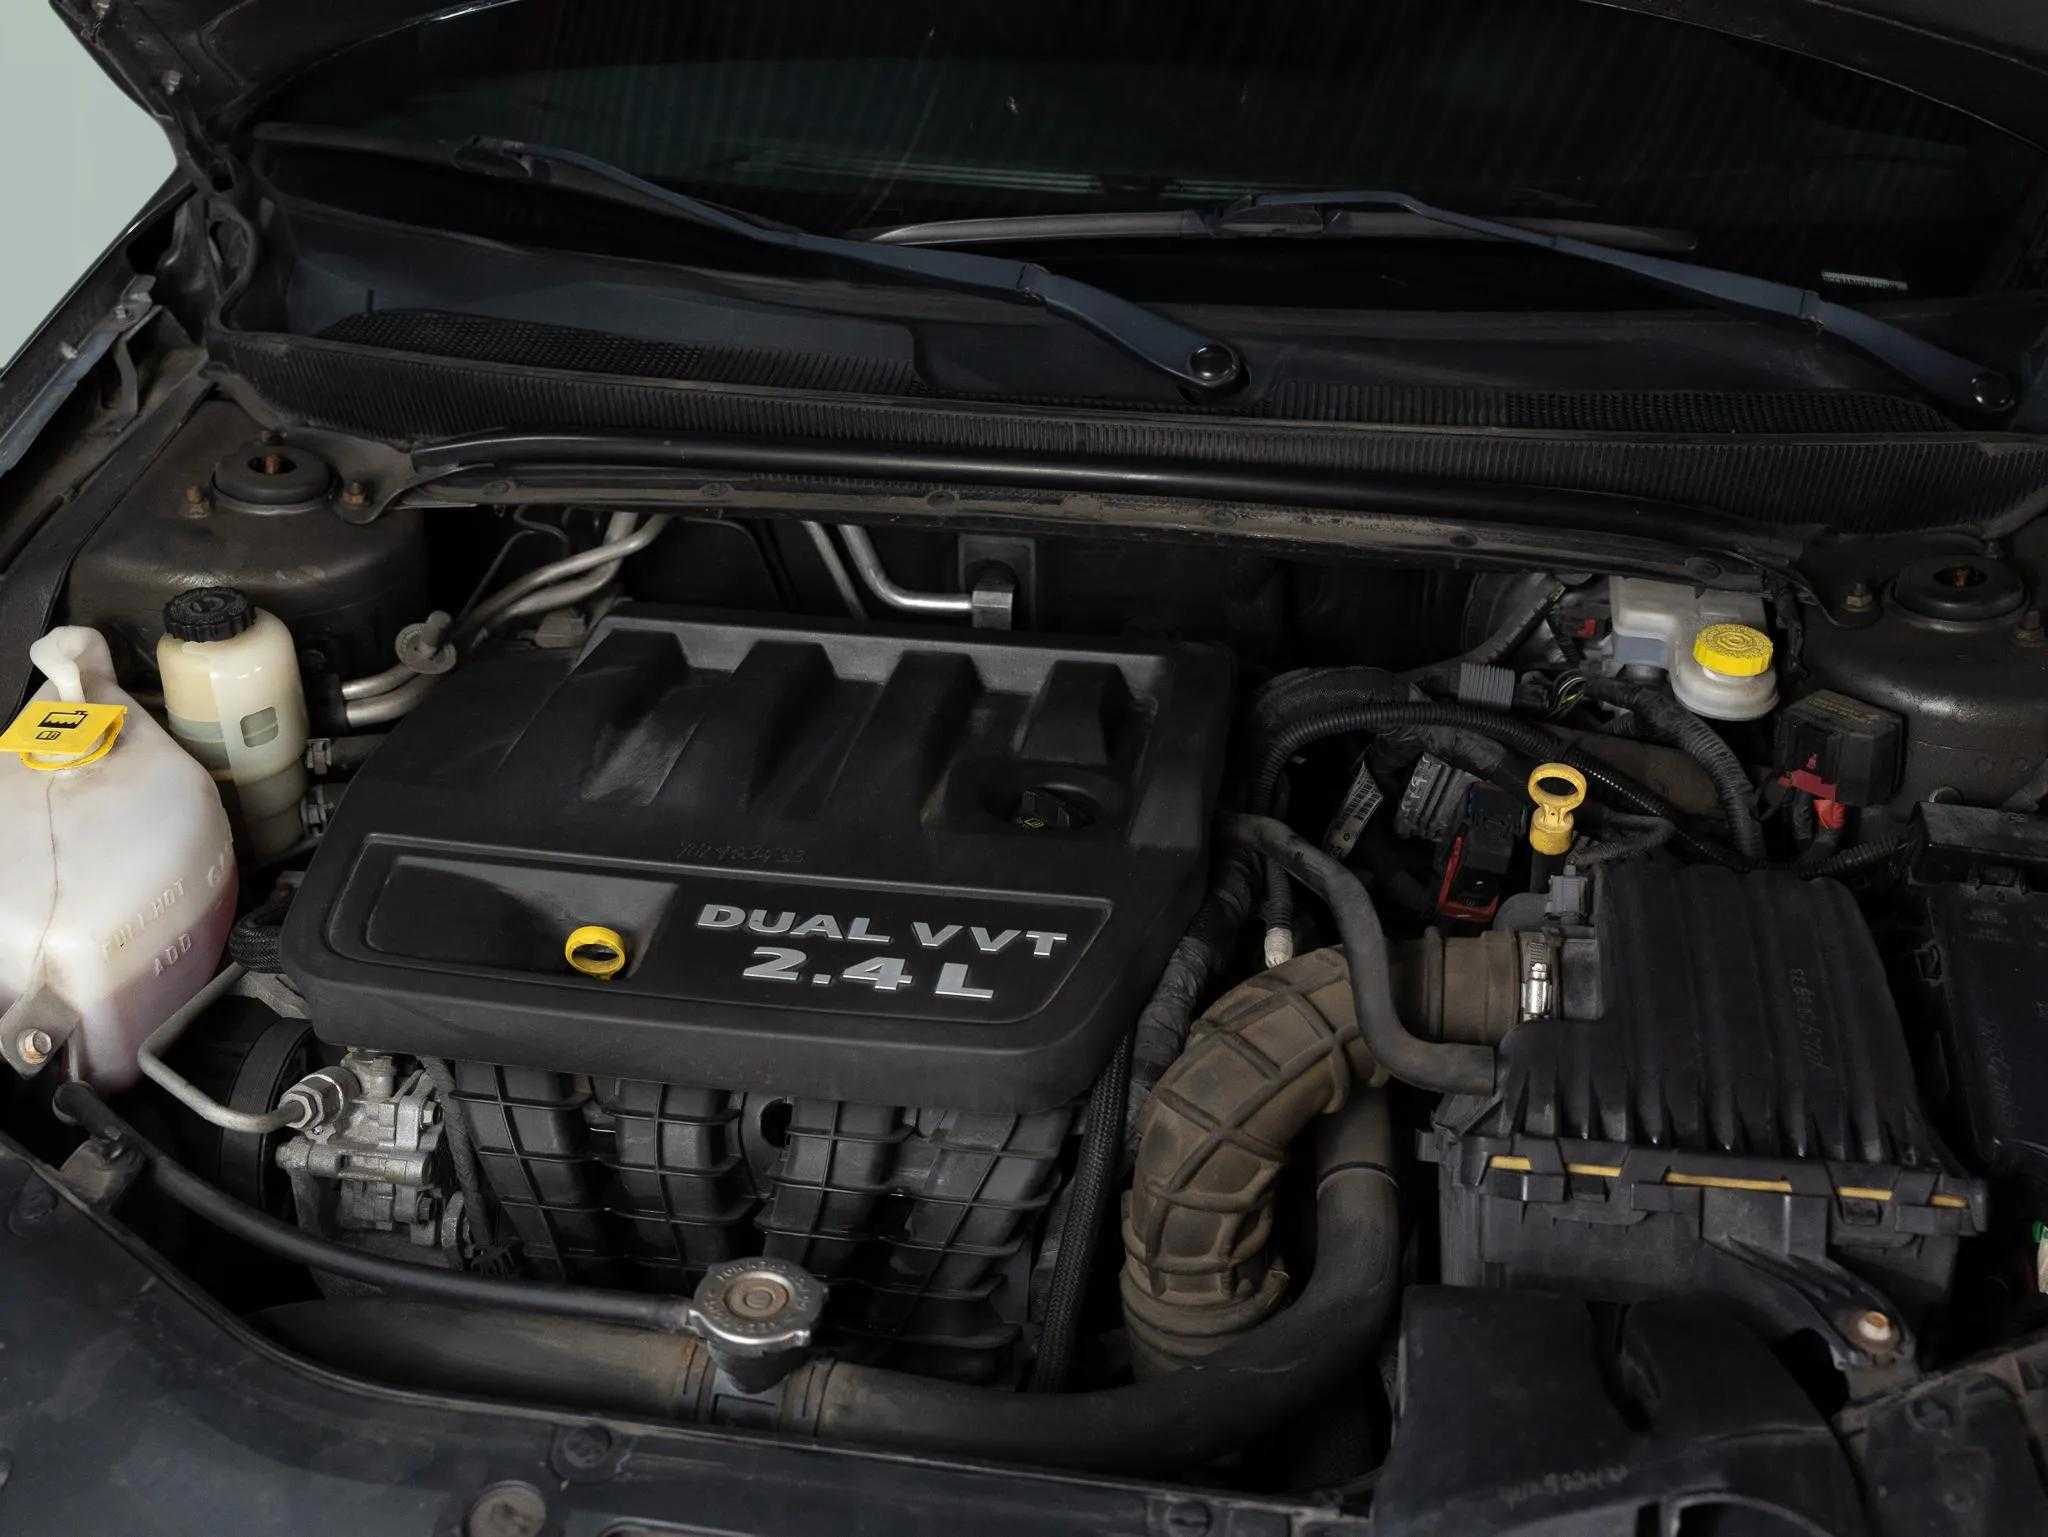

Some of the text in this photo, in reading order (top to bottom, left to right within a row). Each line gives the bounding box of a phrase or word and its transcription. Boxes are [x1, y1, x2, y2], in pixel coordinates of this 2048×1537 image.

[151, 877, 185, 920] HOT
[152, 932, 192, 976] ADD
[696, 903, 1068, 957] DUAL VVT
[742, 946, 995, 999] 2.4 L
